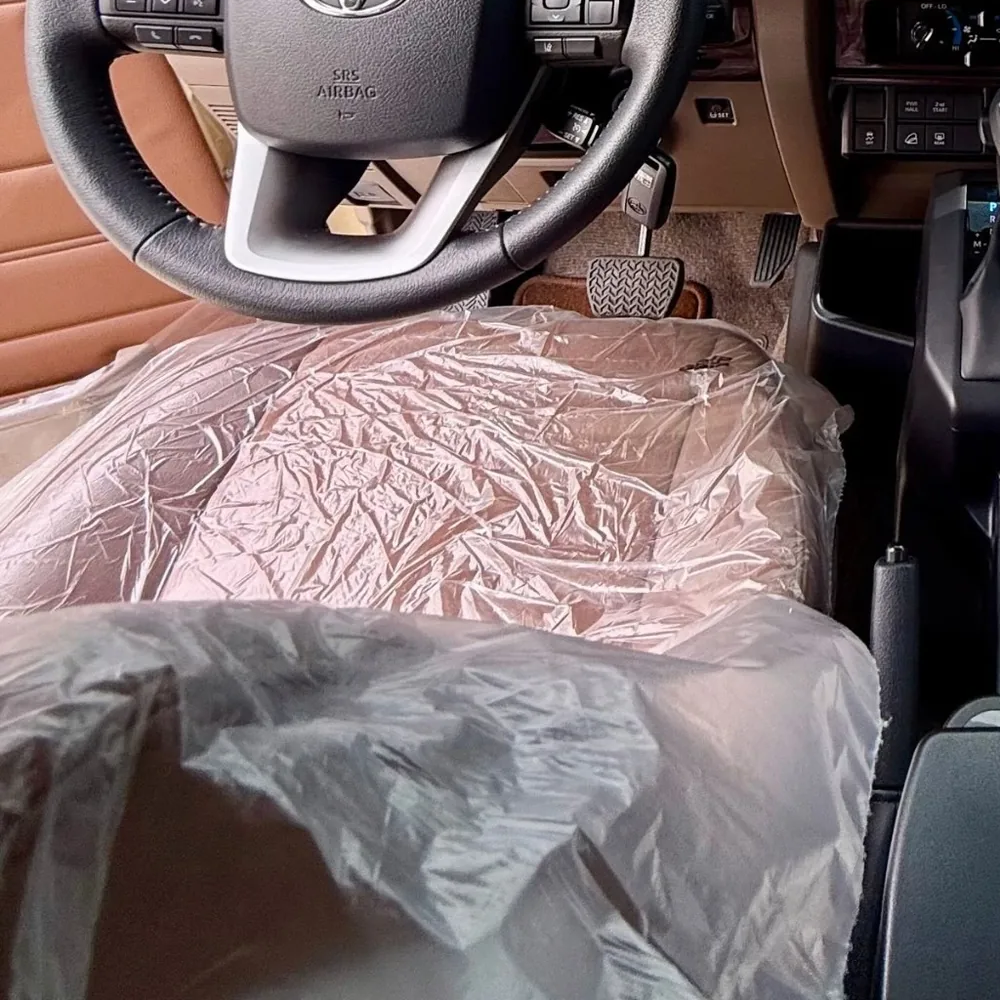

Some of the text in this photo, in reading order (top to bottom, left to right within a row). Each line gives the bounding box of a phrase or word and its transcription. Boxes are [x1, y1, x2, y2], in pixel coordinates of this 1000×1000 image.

[333, 68, 360, 81] SRS
[317, 85, 377, 99] AIRBAG
[989, 202, 997, 211] P
[989, 215, 996, 223] R
